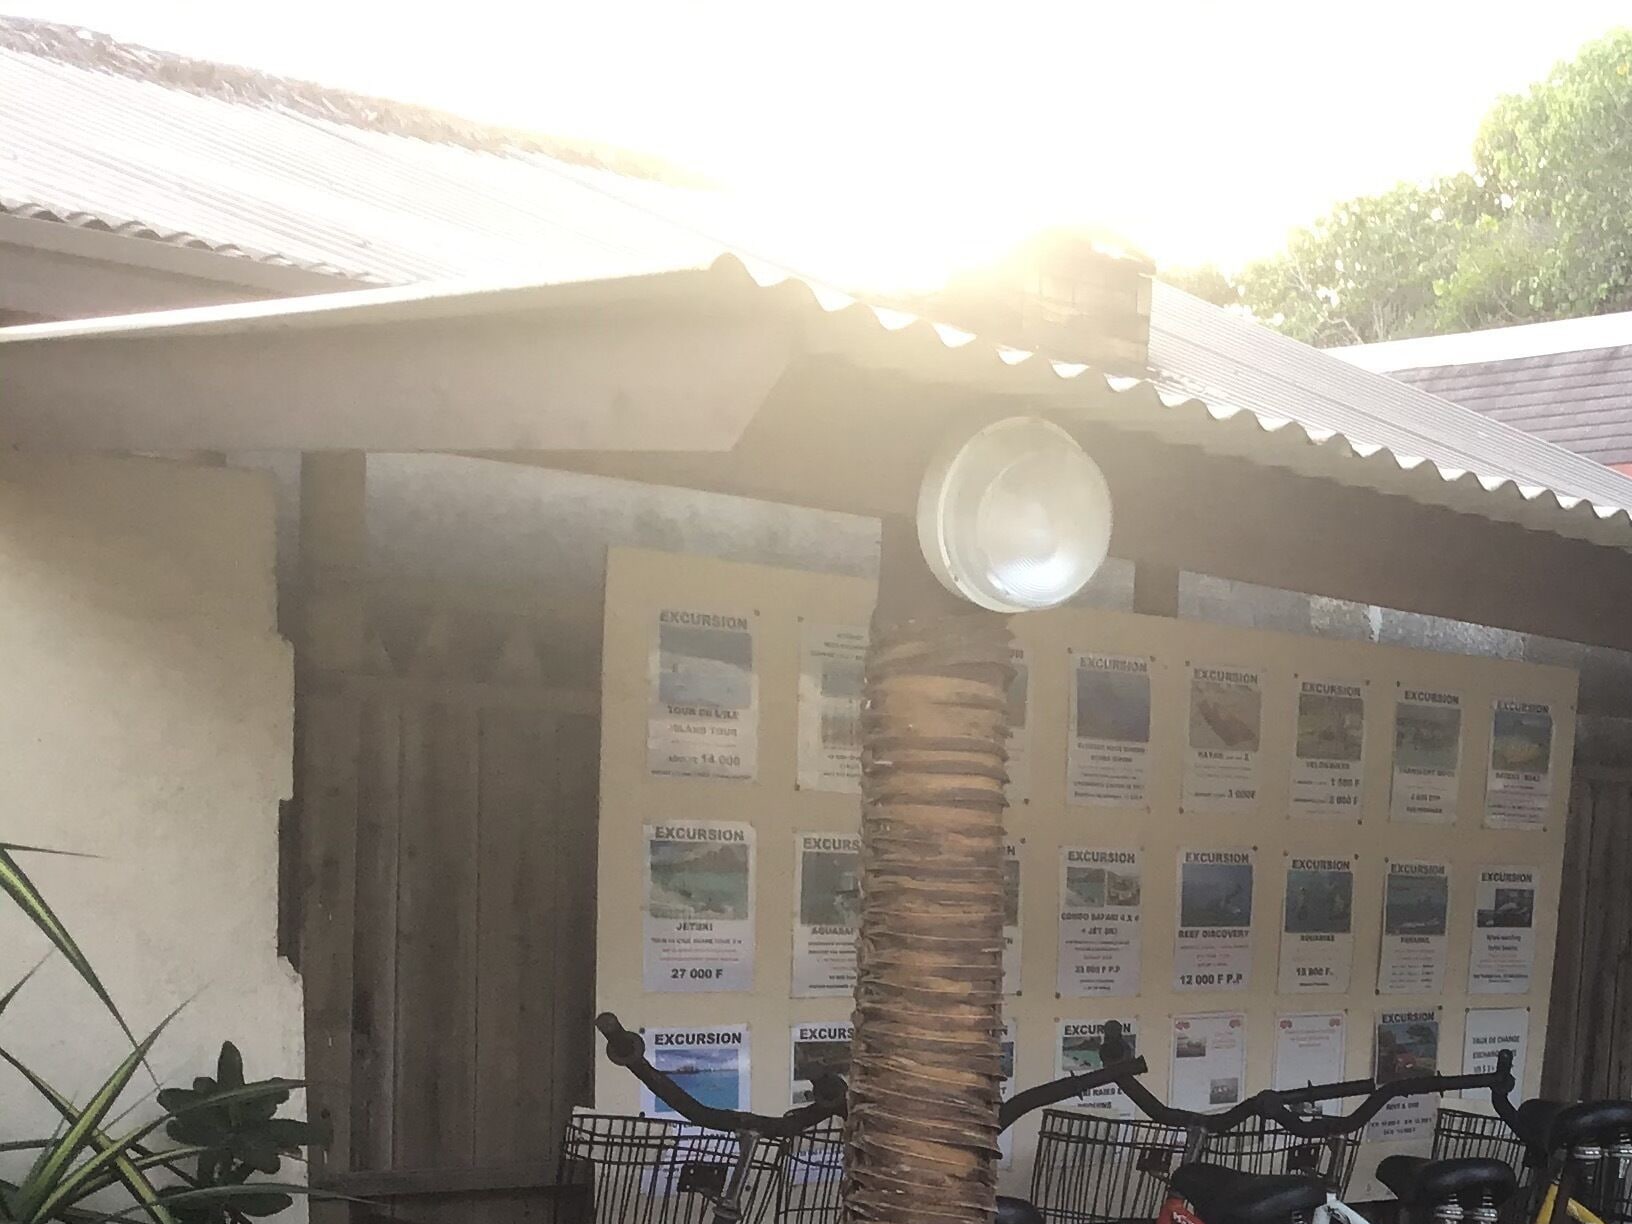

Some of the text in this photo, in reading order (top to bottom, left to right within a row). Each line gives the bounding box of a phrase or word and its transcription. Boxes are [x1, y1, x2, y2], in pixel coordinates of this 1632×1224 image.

[660, 610, 748, 630] EXCURSION
[1080, 657, 1147, 672] EXCURSION
[1194, 668, 1258, 684] EXCURSION
[1302, 682, 1361, 697] EXCURSION
[1404, 690, 1459, 704] EXCURSION
[655, 826, 744, 841] EXCURSION
[803, 838, 861, 850] EXCURS
[1068, 850, 1135, 864] EXCURSION
[1185, 851, 1250, 864] EXCURSION
[1292, 860, 1350, 870] EXCURSION
[1391, 863, 1445, 875] EXCURSION
[1481, 872, 1532, 883] EXCURSION
[1202, 930, 1250, 938] DISCOVERY
[671, 968, 724, 979] 27 000 F
[1179, 974, 1194, 985] 12
[1195, 974, 1216, 985] 000
[1217, 974, 1224, 984] F
[1382, 1012, 1435, 1023] EXCURSION
[800, 1027, 854, 1040] EXCURS
[1064, 1022, 1131, 1036] EXCURN
[654, 1032, 743, 1046] EXCURSION
